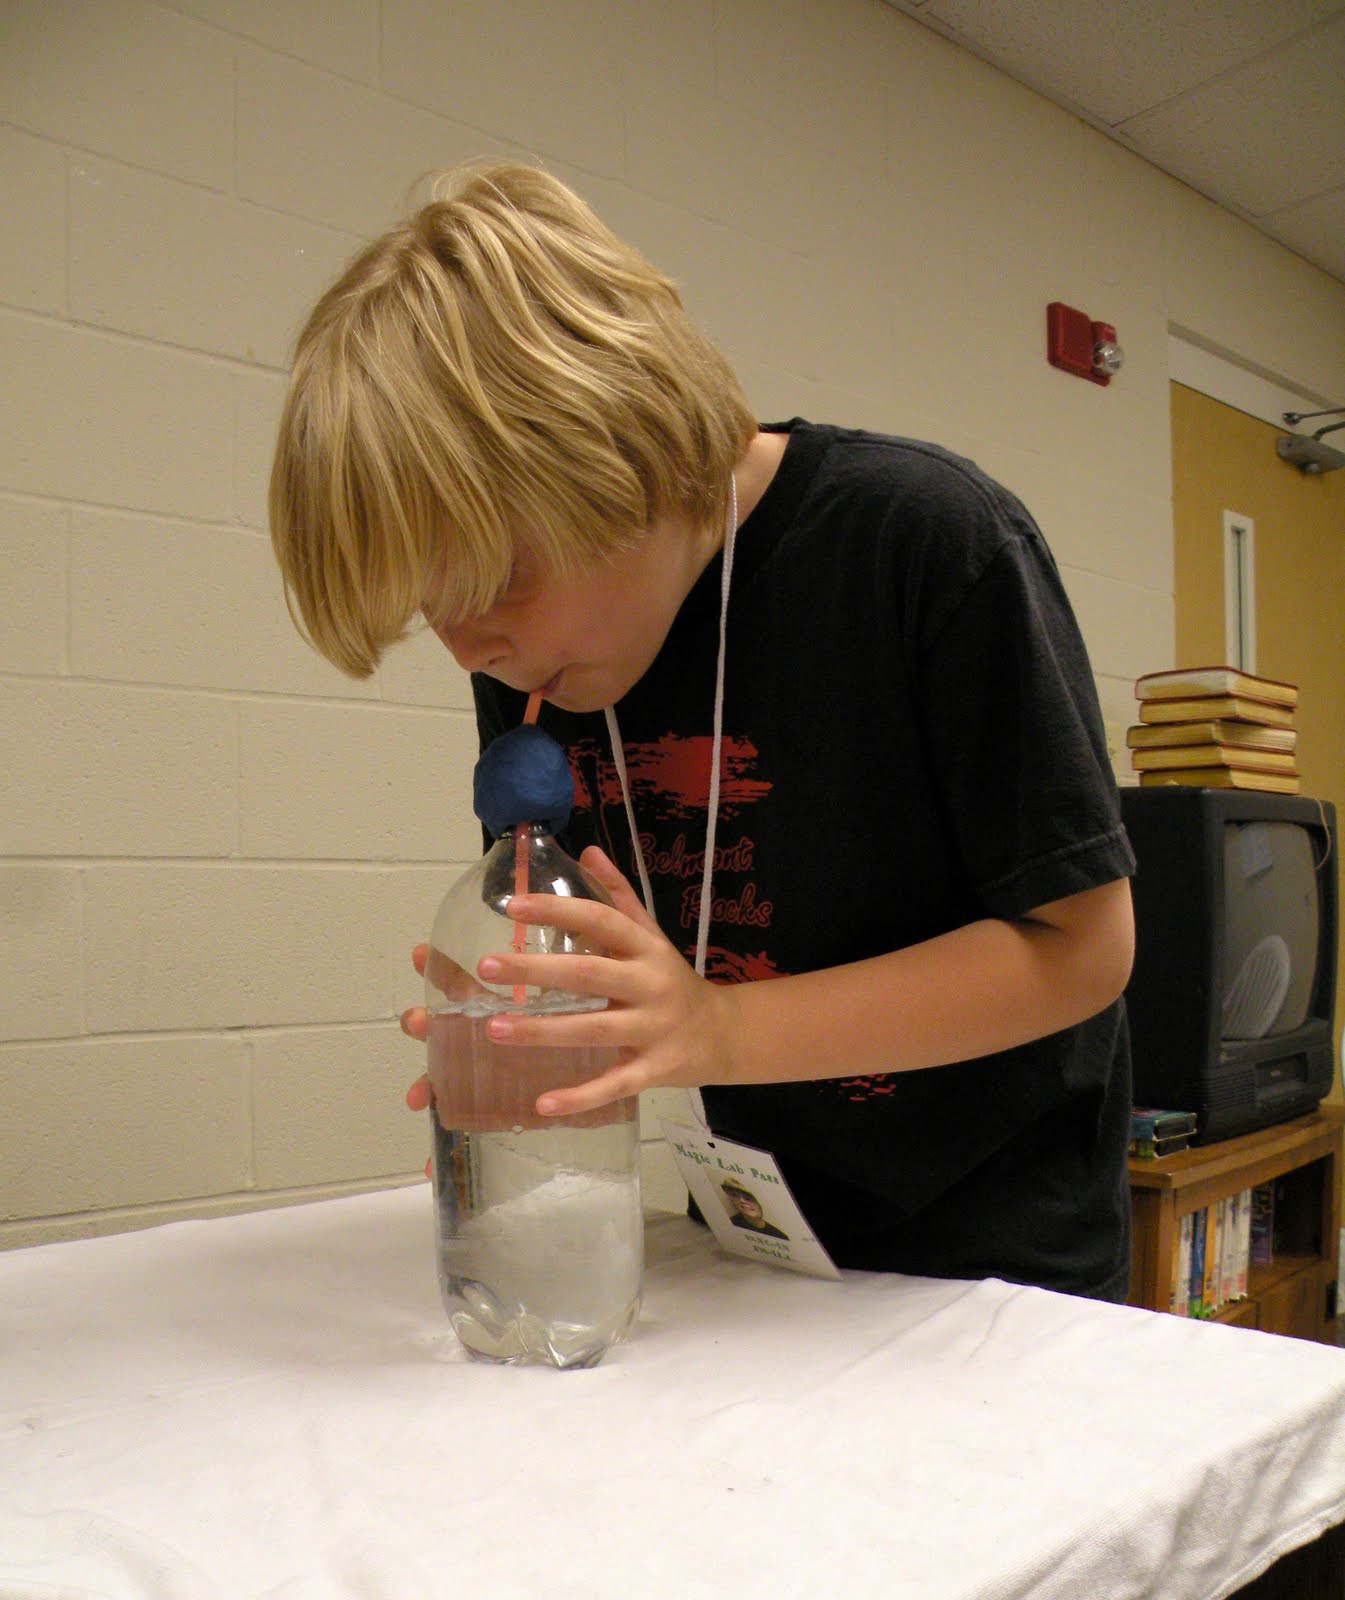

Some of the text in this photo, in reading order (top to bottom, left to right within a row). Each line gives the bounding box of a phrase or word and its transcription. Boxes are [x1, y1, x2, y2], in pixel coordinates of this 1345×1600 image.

[632, 834, 754, 878] Belmont
[680, 882, 773, 927] Rocks
[674, 1143, 711, 1165] Magic
[716, 1157, 744, 1174] Lab
